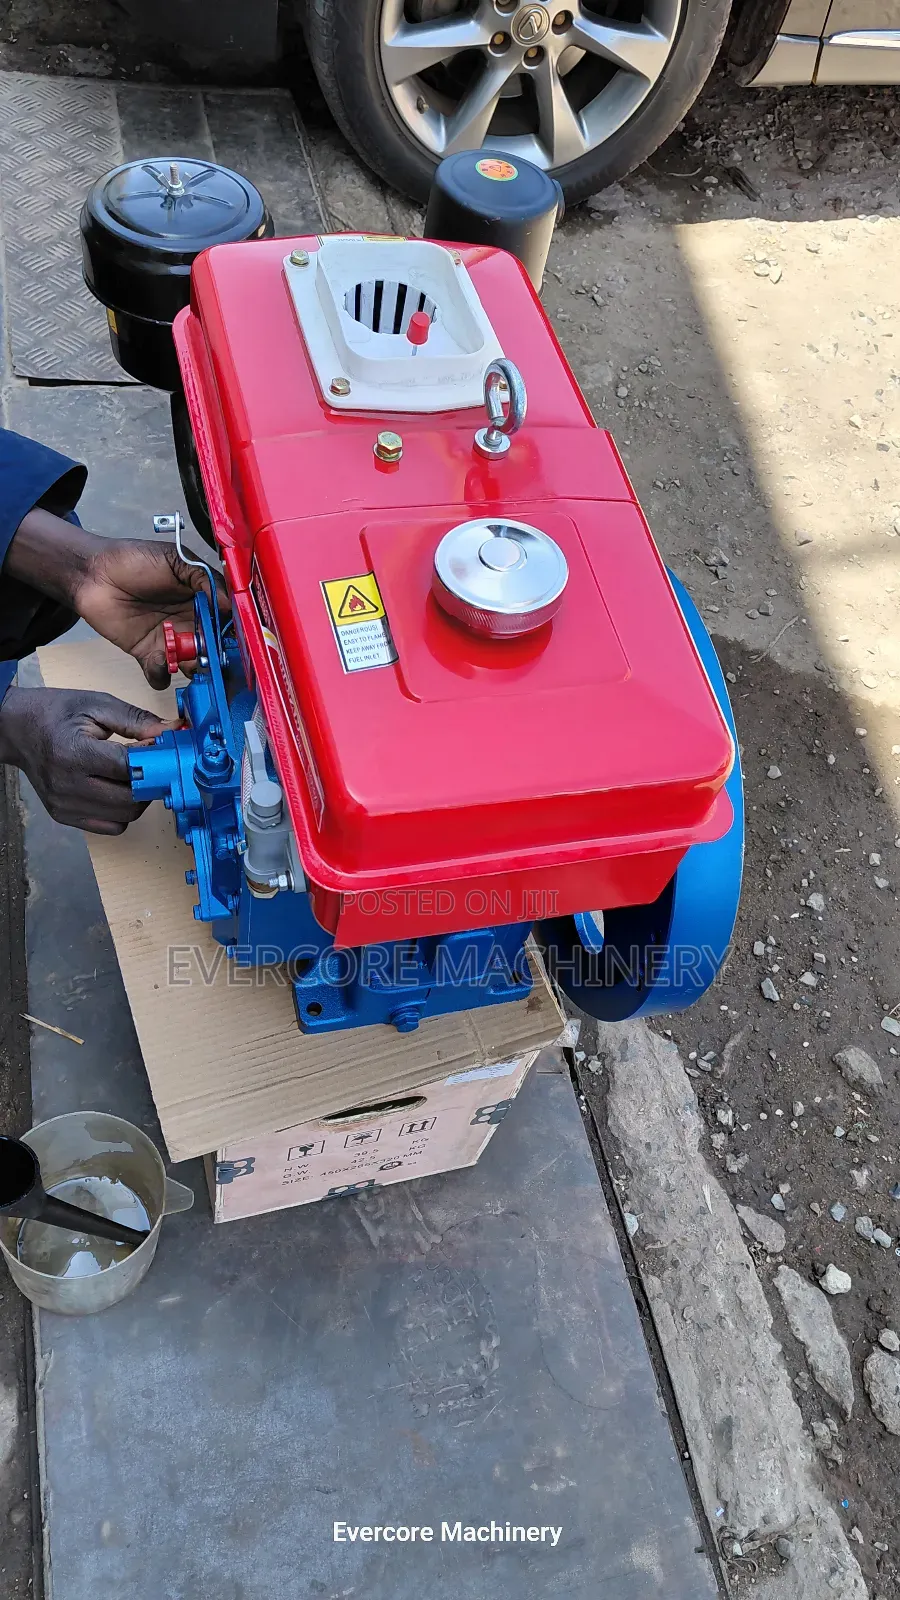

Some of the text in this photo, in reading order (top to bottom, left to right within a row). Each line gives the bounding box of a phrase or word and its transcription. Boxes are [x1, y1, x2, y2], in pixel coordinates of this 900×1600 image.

[343, 636, 359, 646] EASY
[359, 634, 368, 643] TO
[345, 646, 361, 655] KEEP
[361, 643, 376, 652] AWAY
[348, 655, 364, 664] FUEL
